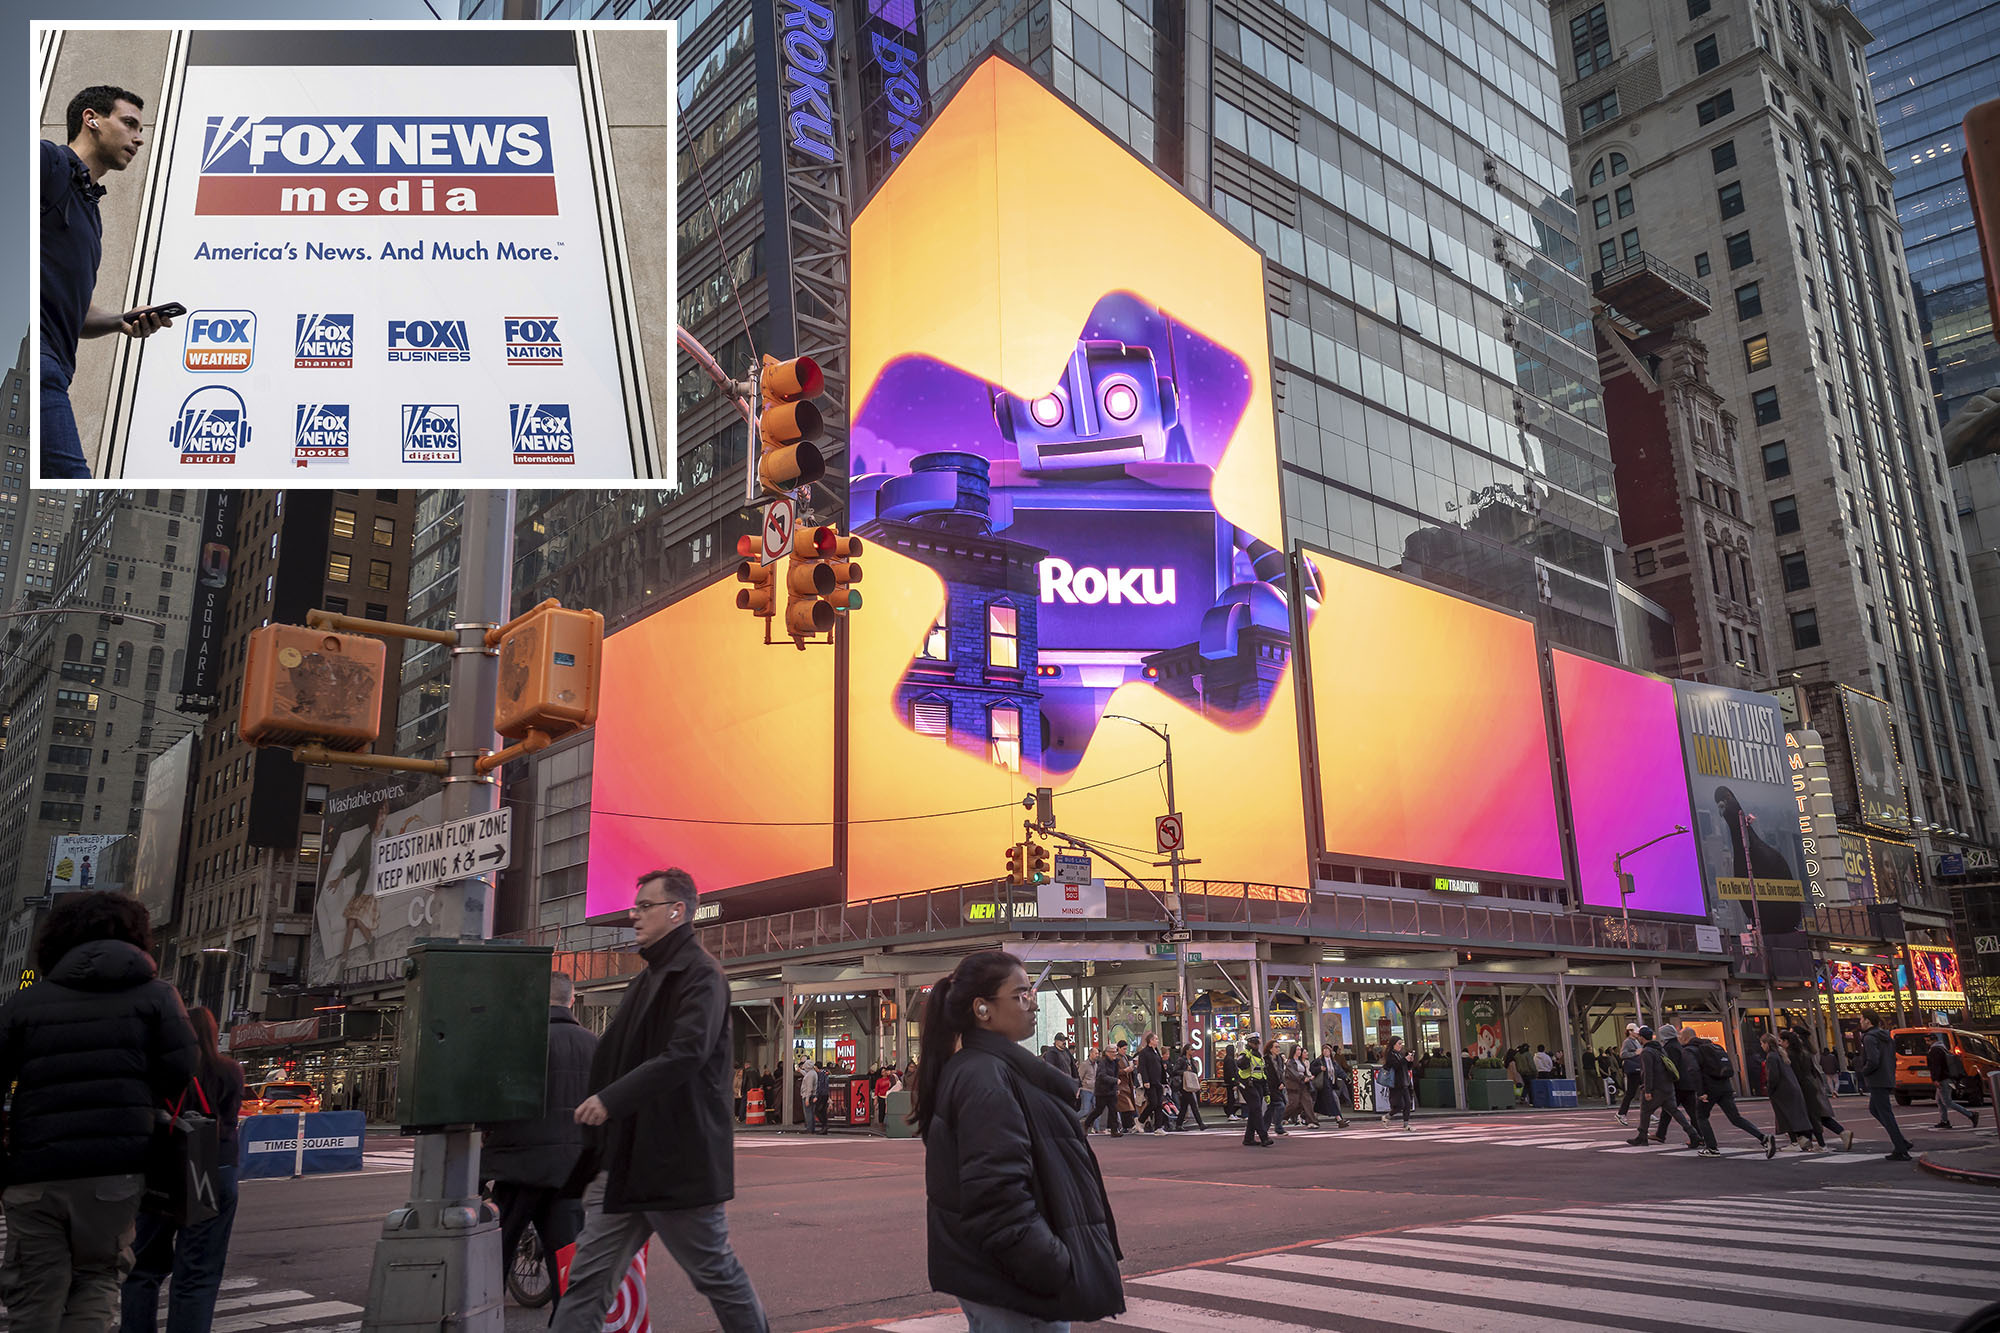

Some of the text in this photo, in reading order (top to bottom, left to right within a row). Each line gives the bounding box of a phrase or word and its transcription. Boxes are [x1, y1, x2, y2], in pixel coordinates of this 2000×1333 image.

[249, 123, 543, 166] FOX NEWS
[280, 180, 477, 212] media
[194, 241, 298, 261] America's
[306, 242, 372, 261] News.
[380, 241, 424, 261] And
[432, 241, 488, 261] Much
[191, 319, 250, 343] FOX
[314, 325, 351, 341] FOX
[388, 321, 457, 347] FOX
[505, 320, 560, 342] FOX
[303, 341, 352, 356] NEWS
[507, 346, 562, 357] NATION
[188, 352, 247, 365] WEATHER
[388, 352, 470, 361] BUSINESS
[201, 421, 236, 436] FOX
[314, 416, 347, 430] FOX
[422, 418, 456, 432] FOX
[530, 417, 568, 434] FOX
[190, 437, 235, 451] NEWS
[303, 431, 348, 445] NEWS
[412, 434, 457, 448] NEWS
[520, 435, 572, 450] NEWS
[297, 448, 346, 456] books
[409, 452, 456, 461] digital
[515, 455, 573, 463] international
[196, 593, 215, 687] SQUARE
[1686, 694, 1777, 745] IT AIN'T JUST
[1693, 734, 1785, 784] MANHATTAN
[329, 790, 371, 814] Washable
[378, 814, 508, 864] PEDESTRIAN FLOW ZONE
[377, 857, 447, 892] KEEP MOVING
[837, 1045, 855, 1057] MINI
[265, 1138, 344, 1150] TIMES SQUARE
